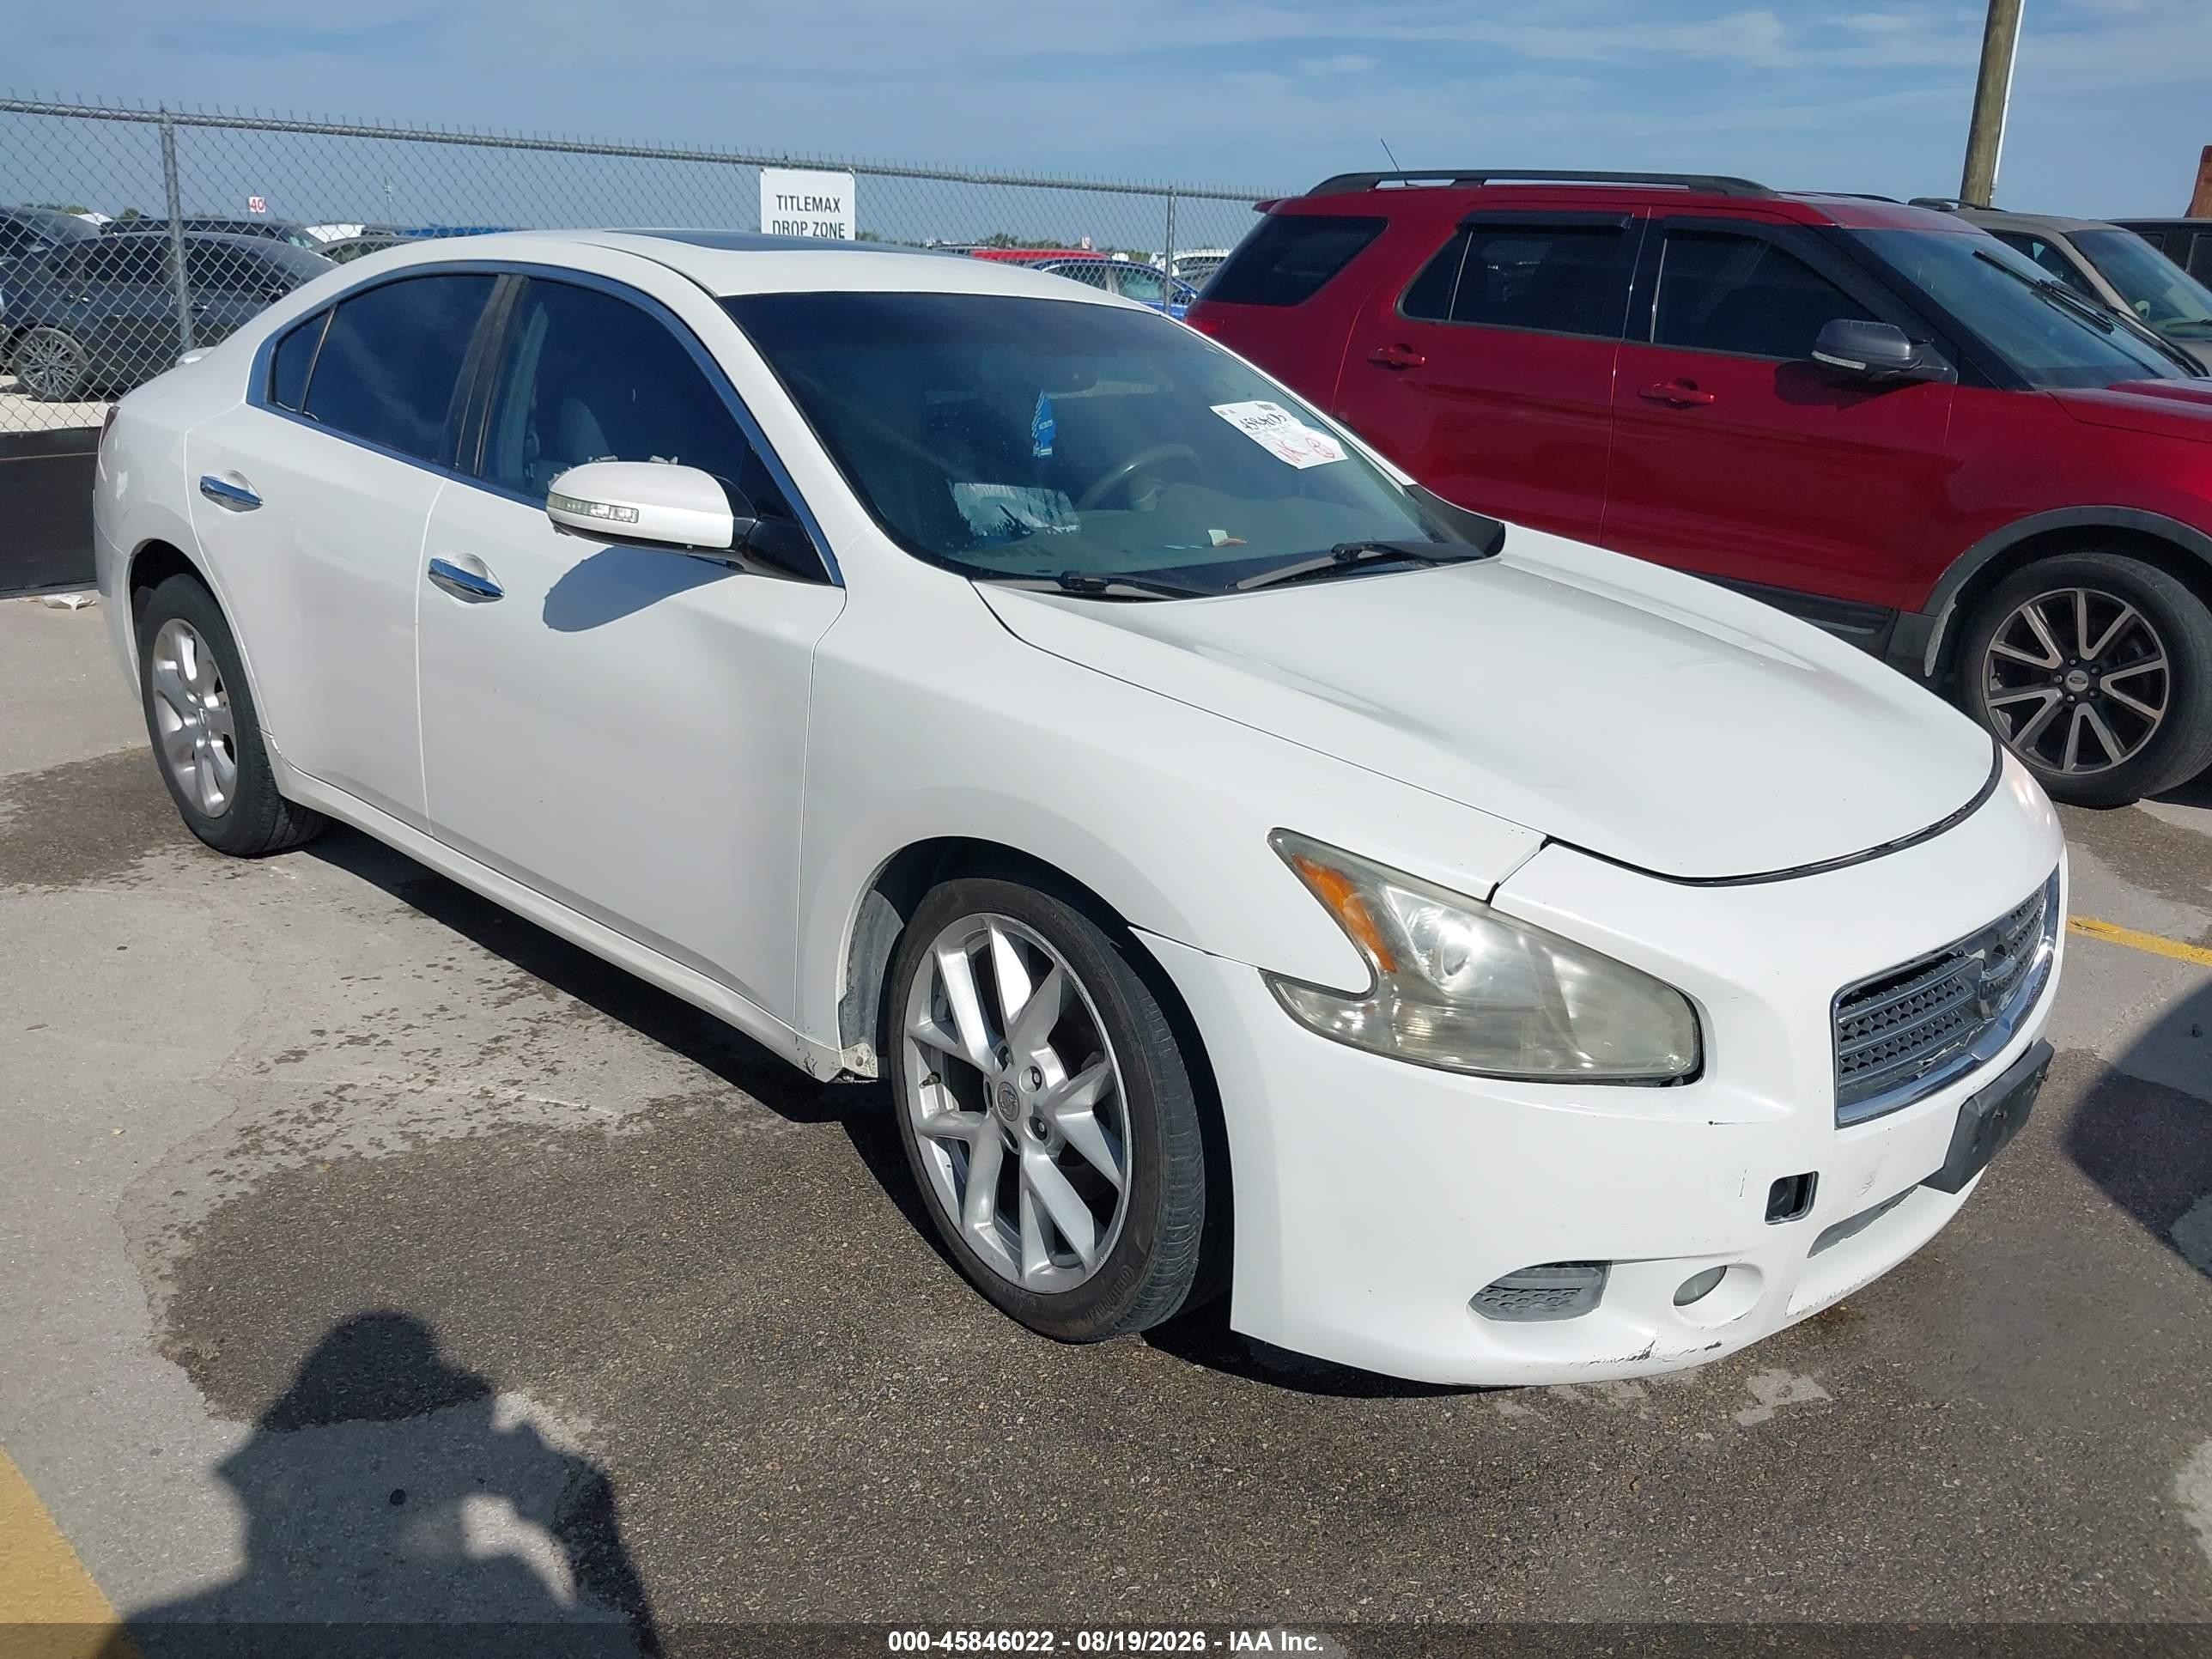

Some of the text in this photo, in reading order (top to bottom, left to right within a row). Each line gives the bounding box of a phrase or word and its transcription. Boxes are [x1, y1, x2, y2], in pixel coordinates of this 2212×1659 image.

[250, 198, 264, 211] 40
[776, 194, 841, 213] TITLEMAX
[773, 220, 845, 239] DROP ZONE
